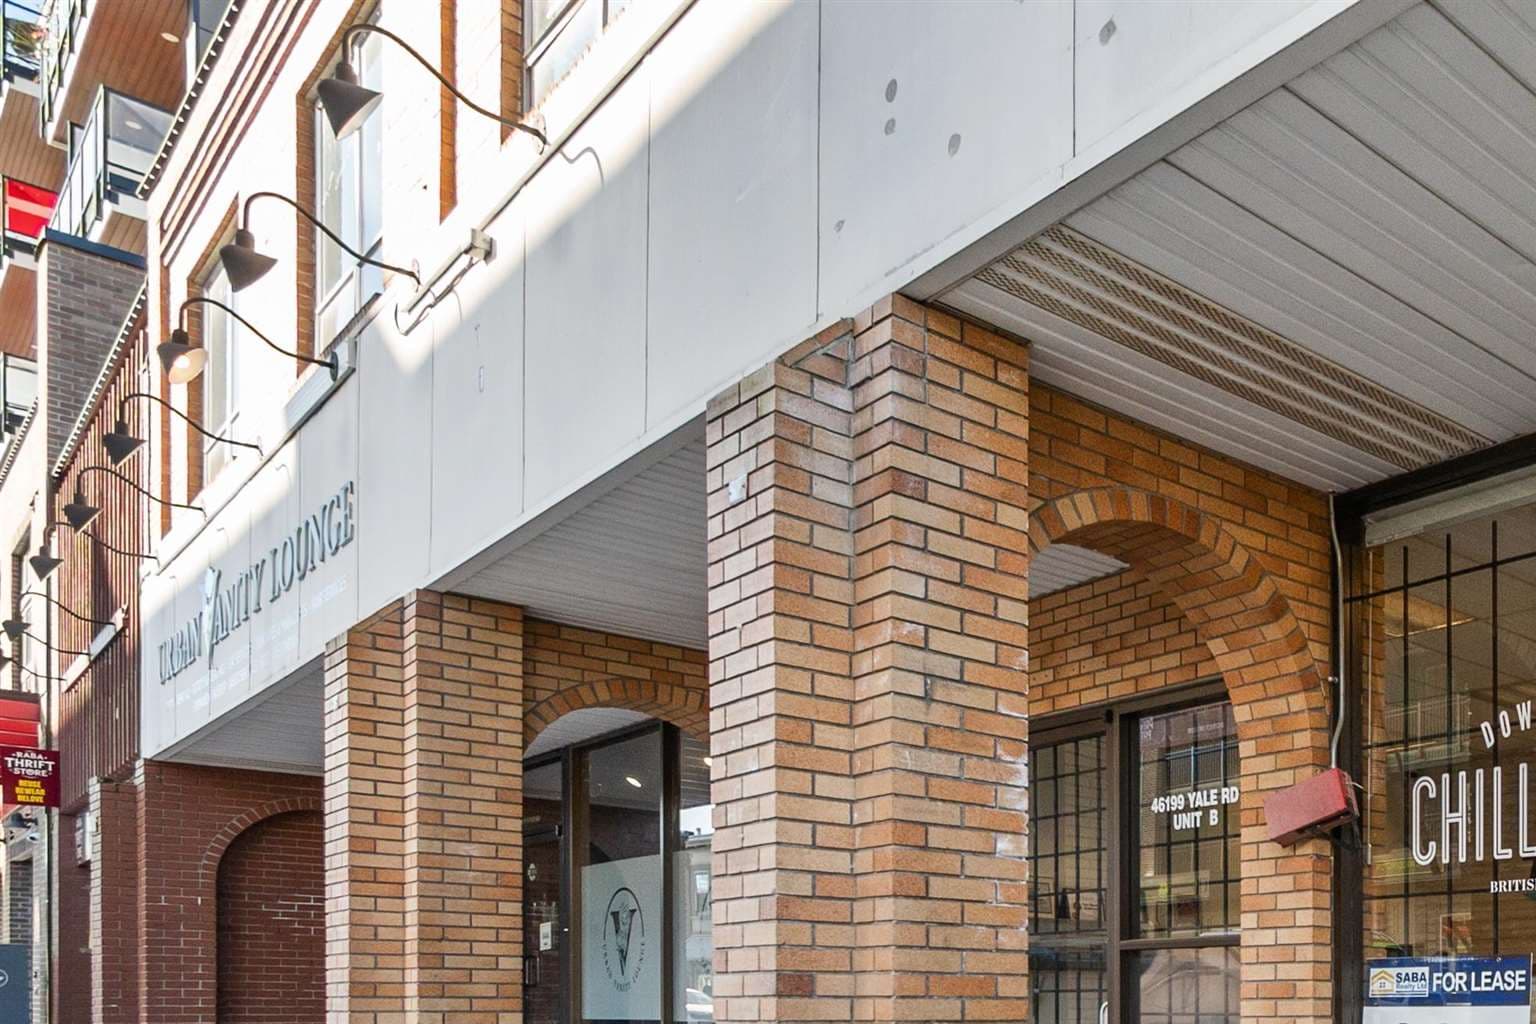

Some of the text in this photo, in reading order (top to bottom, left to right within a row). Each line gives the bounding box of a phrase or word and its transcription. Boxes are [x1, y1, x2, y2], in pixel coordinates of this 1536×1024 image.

[158, 611, 203, 685] URBAN
[203, 558, 266, 670] VANITY
[270, 480, 354, 604] LOUNGE
[4, 757, 56, 772] THRIFT
[13, 767, 48, 777] STORE
[1151, 786, 1240, 814] 46199 YALE RD
[1173, 808, 1218, 831] UNIT B
[1395, 971, 1427, 984] SABA
[1432, 969, 1527, 993] FOR LEASE
